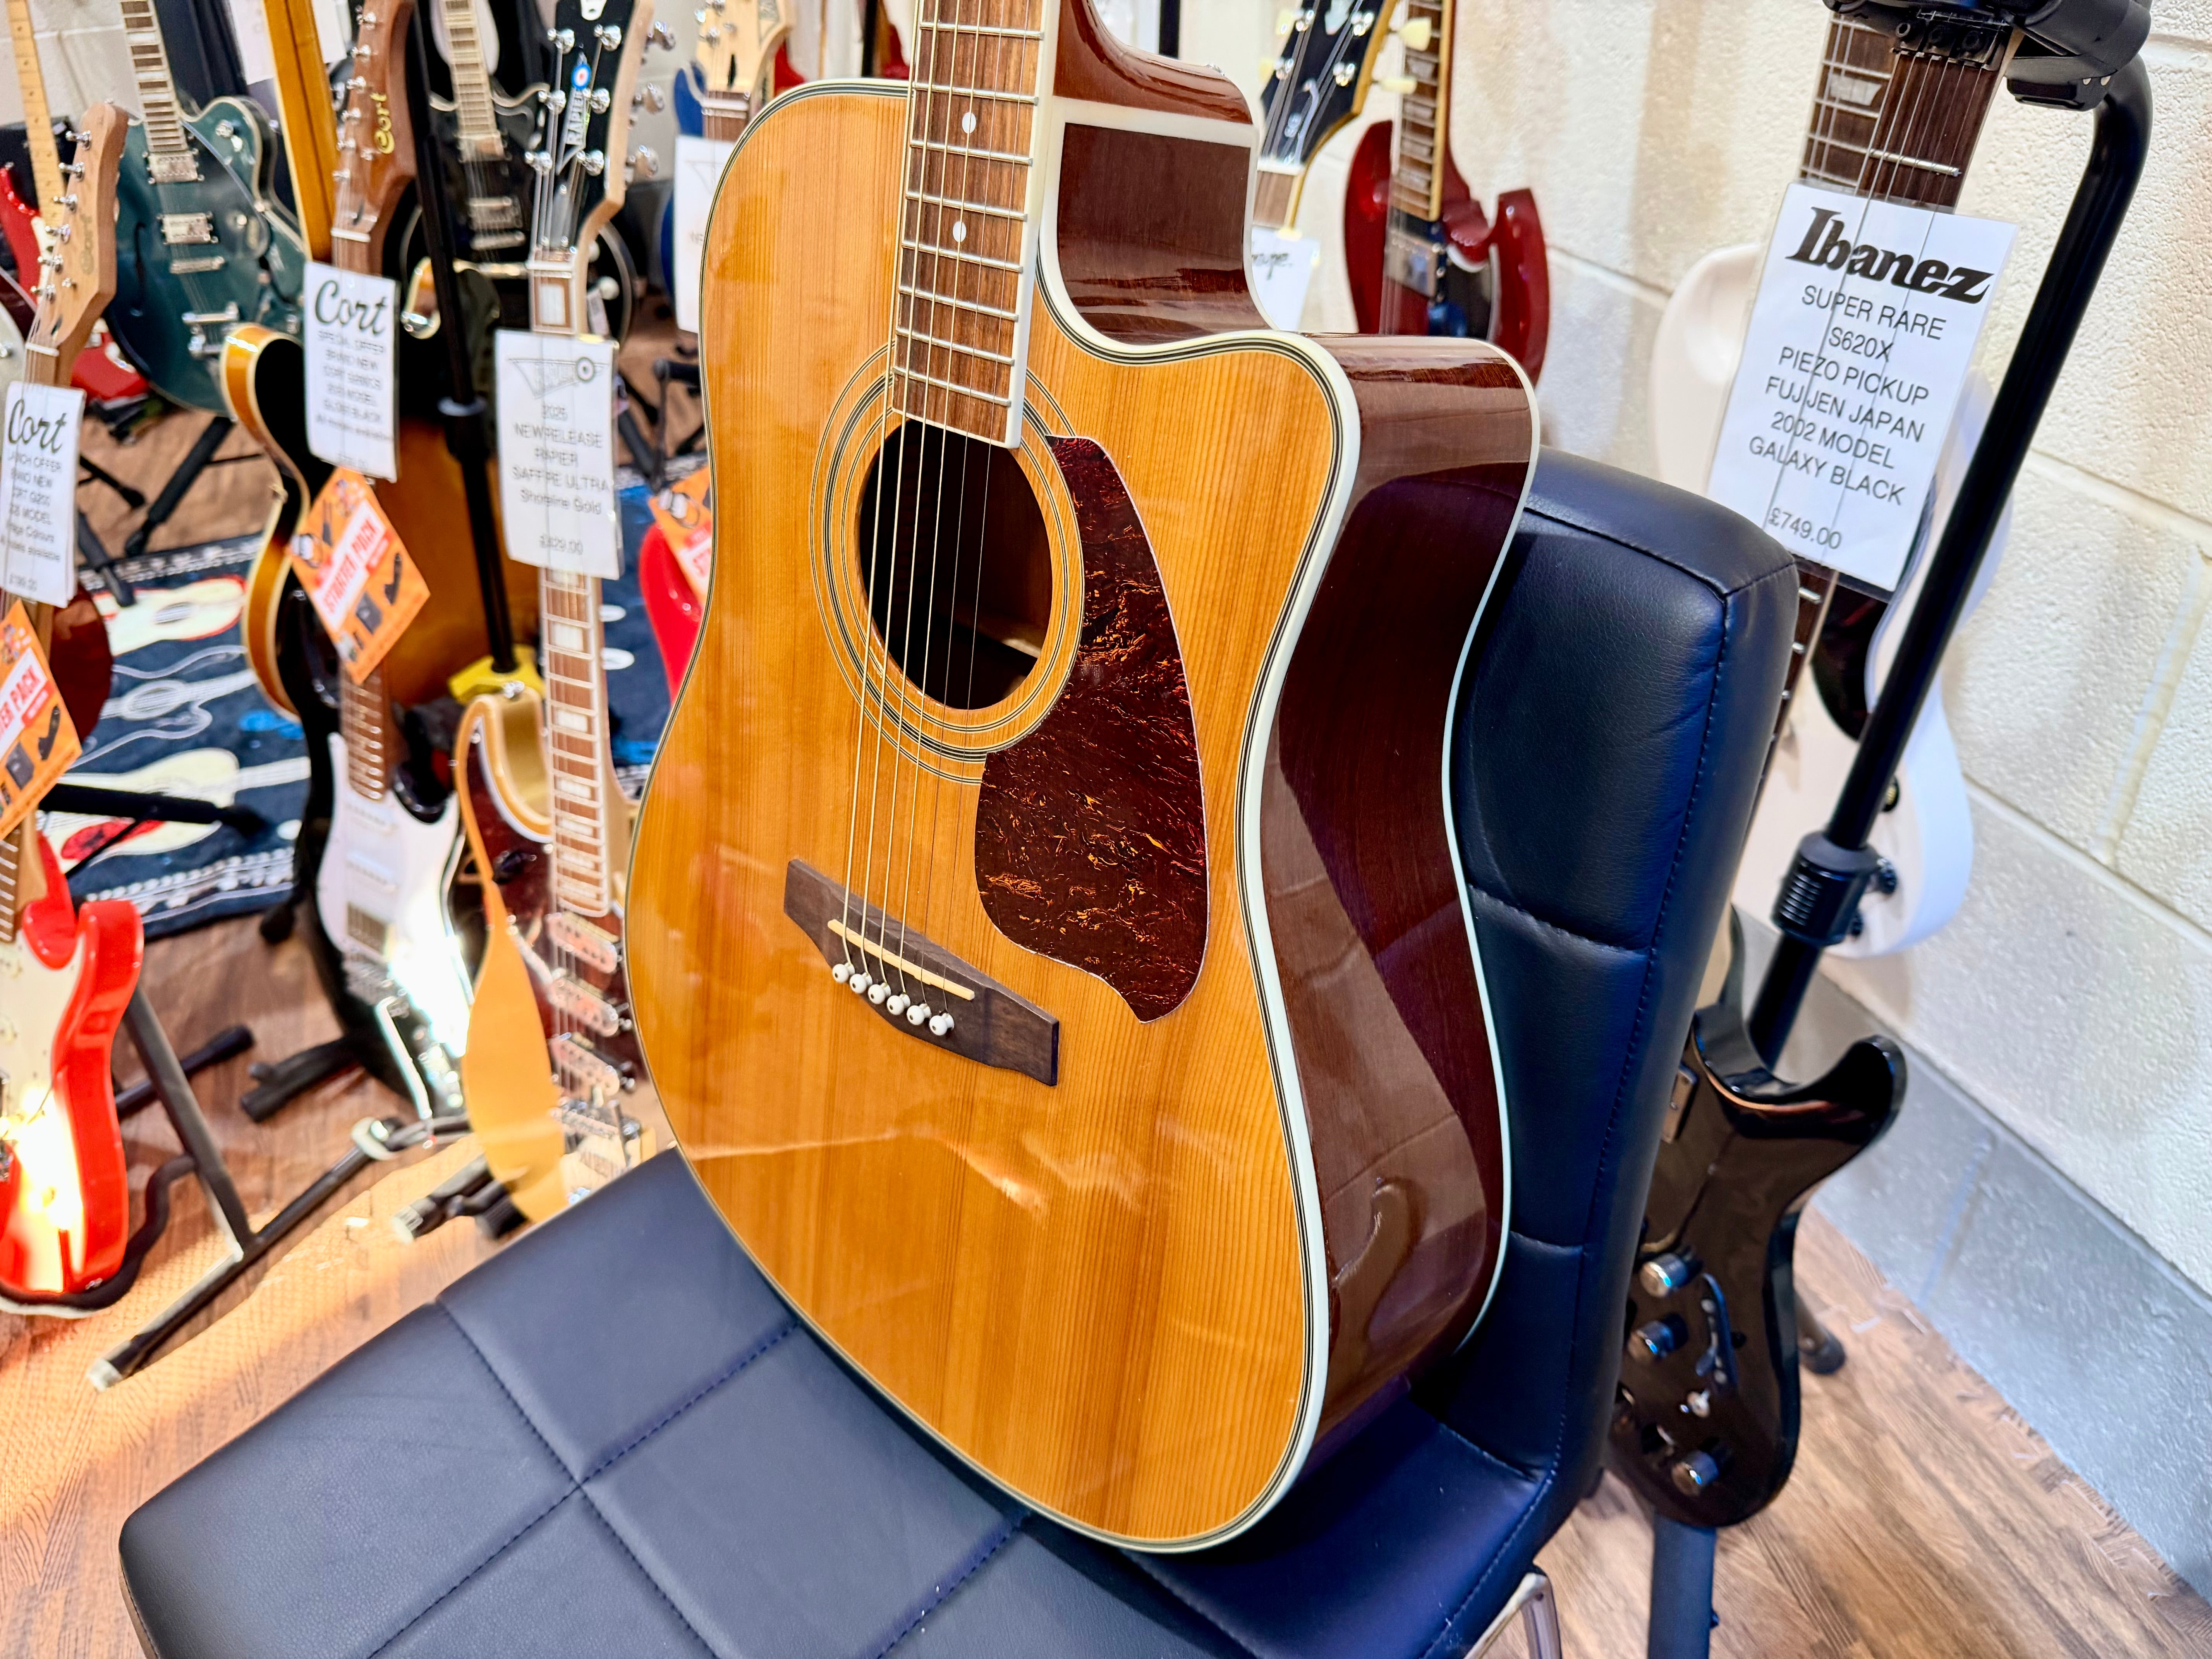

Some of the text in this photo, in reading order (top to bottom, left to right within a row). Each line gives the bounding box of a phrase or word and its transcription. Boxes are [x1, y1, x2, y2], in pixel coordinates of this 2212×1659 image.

[369, 93, 395, 154] Cort
[1785, 207, 1994, 304] Ibanez
[315, 280, 387, 336] Cort
[1802, 285, 1946, 340] SUPER RARE
[1829, 327, 1894, 362] S620X
[1778, 346, 1929, 405] PIEZO PICKUP
[9, 398, 67, 453] Cort
[515, 422, 544, 438] NEW
[1771, 411, 1894, 469] 2002 MODEL
[1849, 405, 1925, 442] JAPAN
[1749, 436, 1906, 505] GALAXY BLACK
[1769, 507, 1841, 550] £749.00
